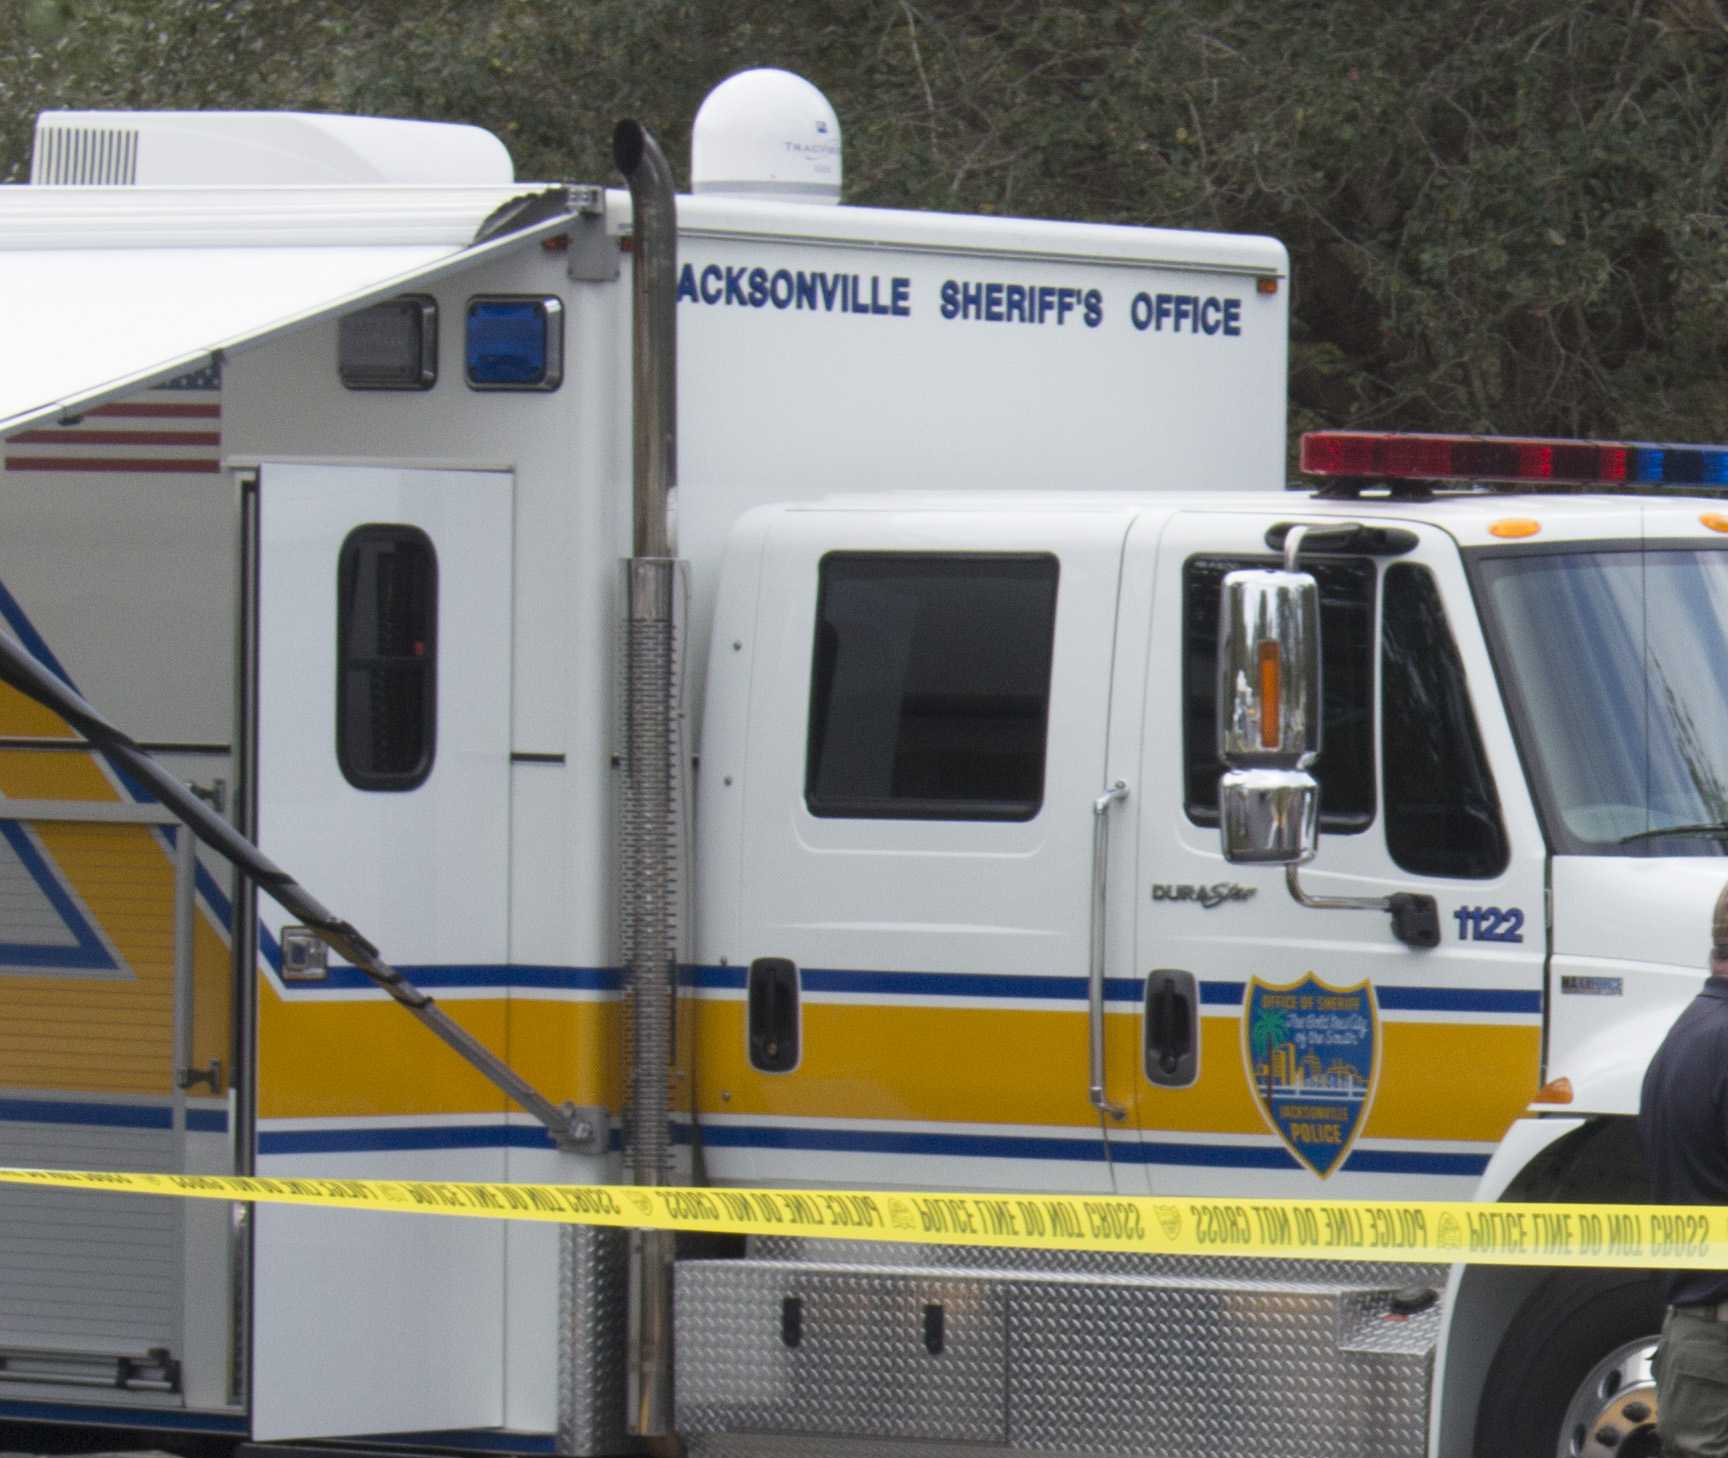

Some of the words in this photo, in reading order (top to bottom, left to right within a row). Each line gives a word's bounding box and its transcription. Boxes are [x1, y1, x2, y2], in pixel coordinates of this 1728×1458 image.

[677, 264, 910, 317] ACKSONVILLE
[940, 280, 1103, 329] SHERIFF'S
[1132, 291, 1243, 338] OFFICE
[1454, 905, 1525, 943] 1122
[1290, 1123, 1342, 1144] POLICE
